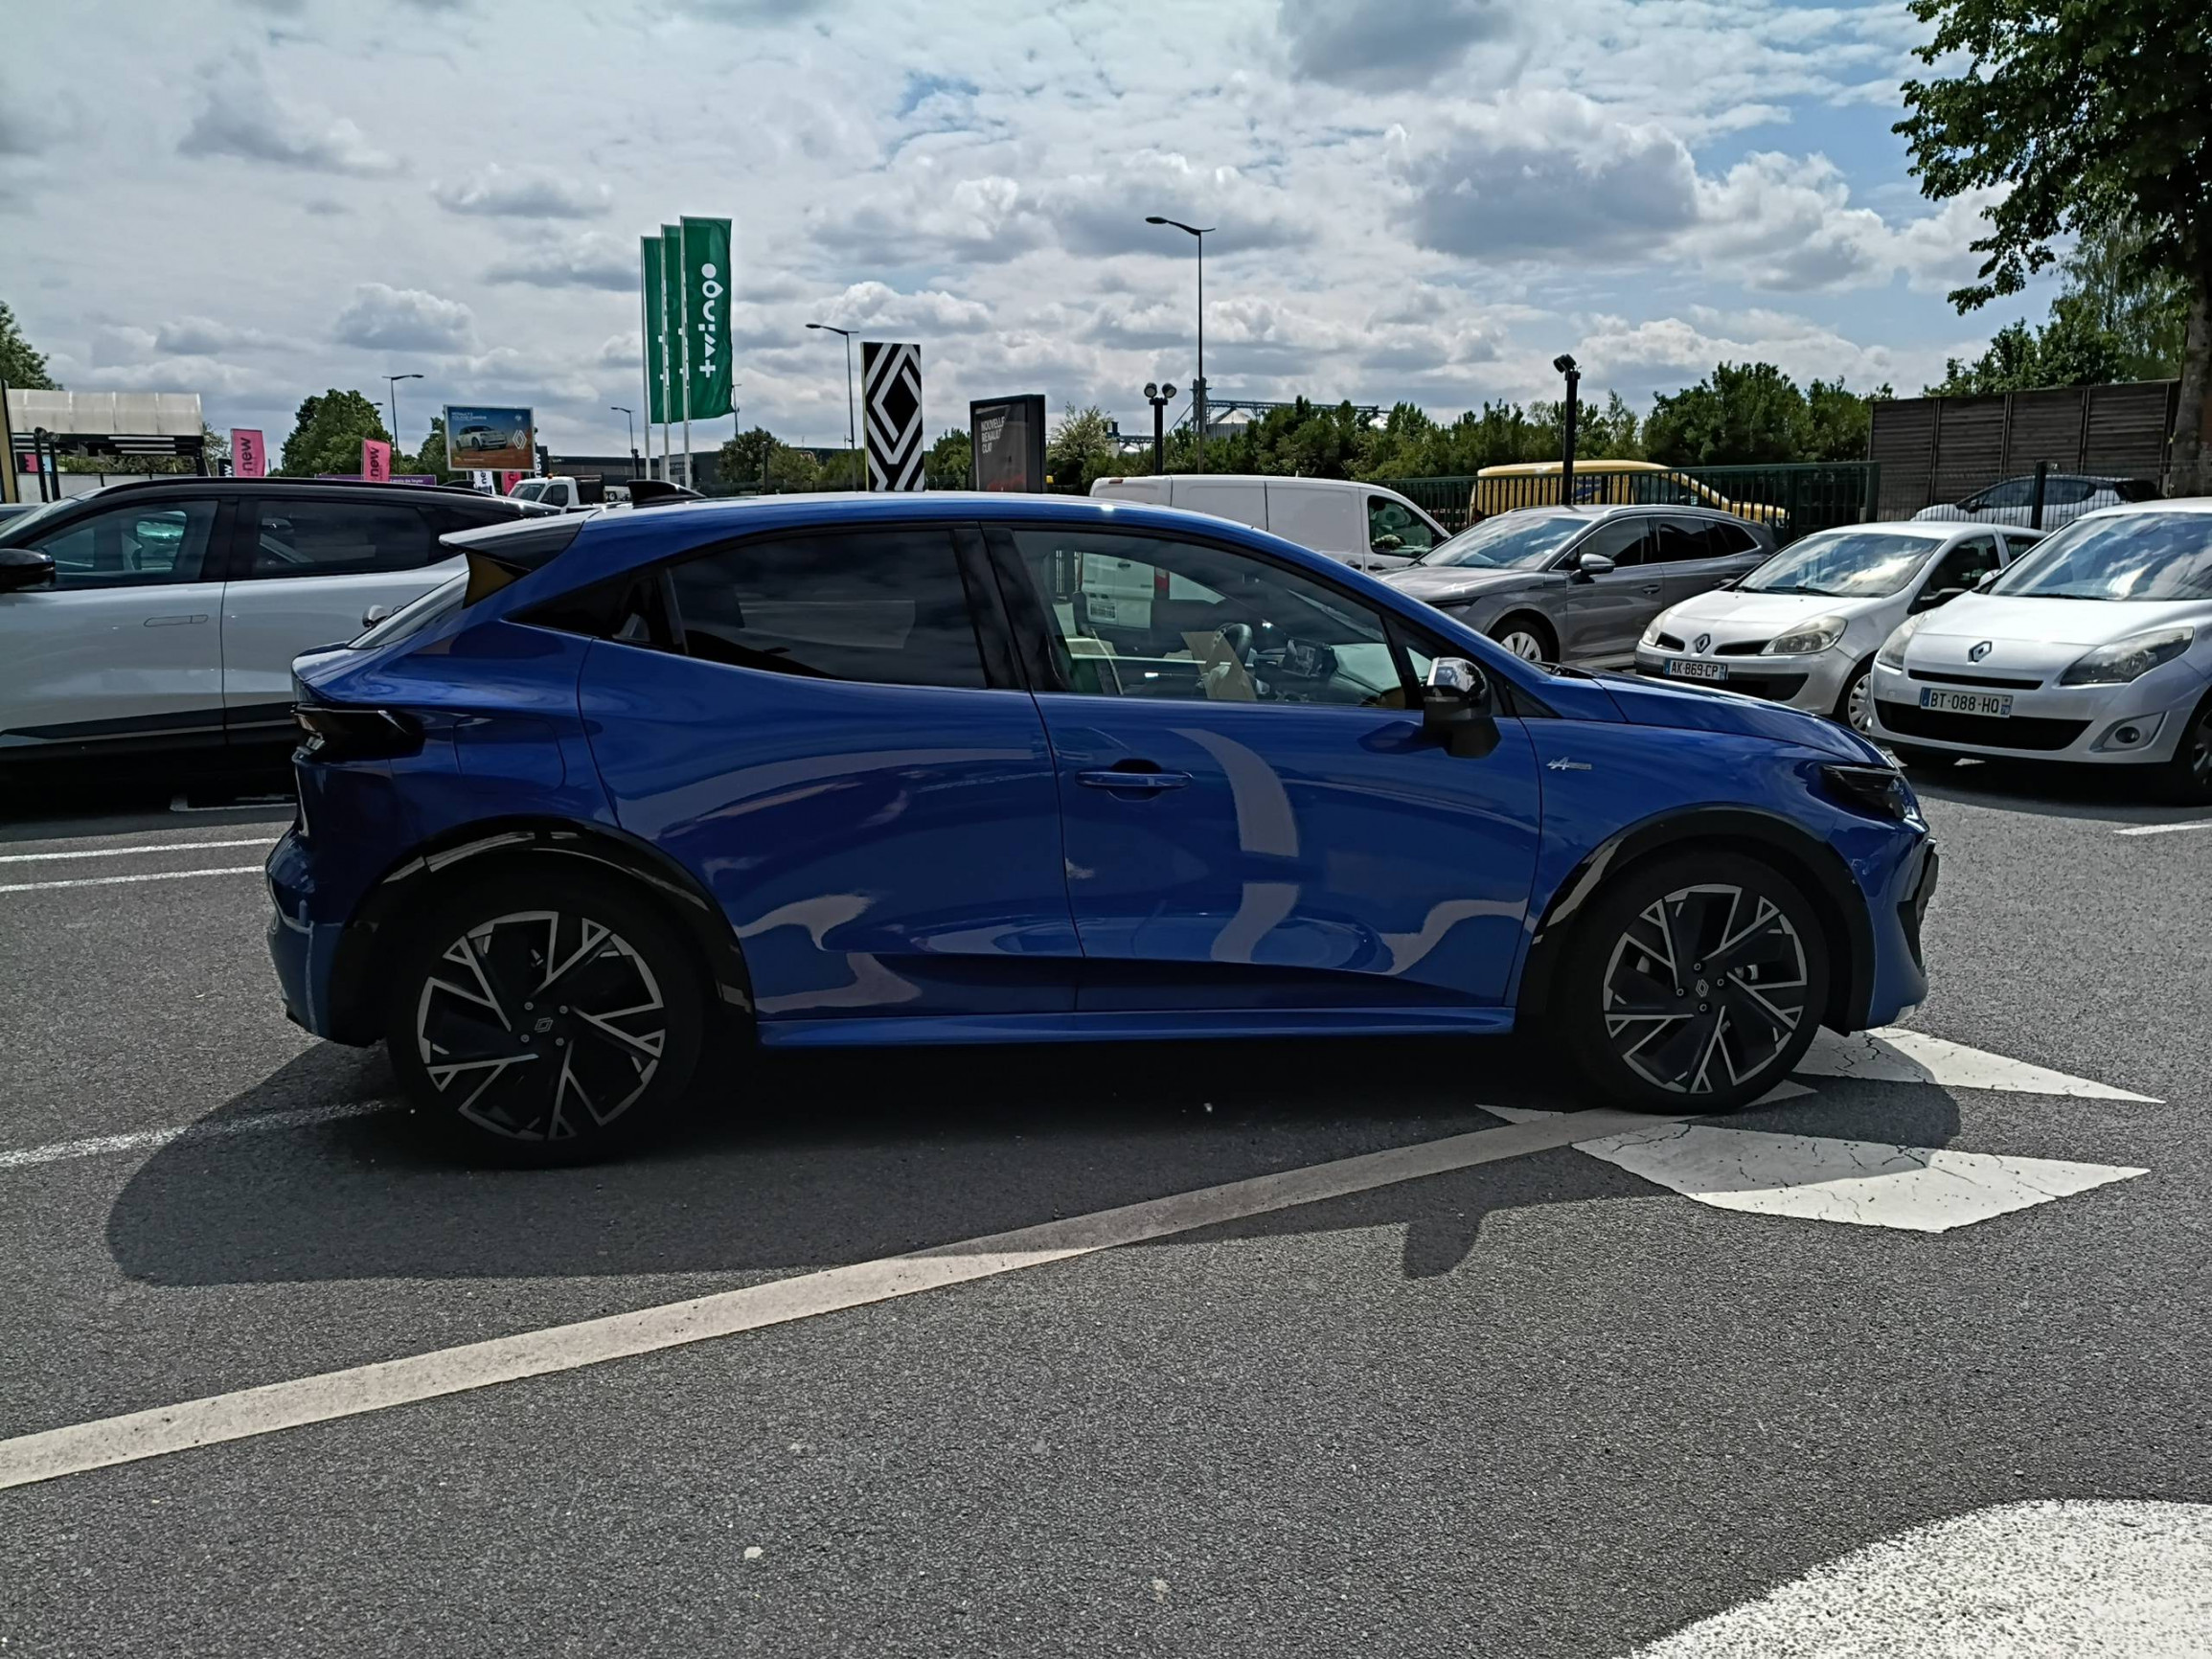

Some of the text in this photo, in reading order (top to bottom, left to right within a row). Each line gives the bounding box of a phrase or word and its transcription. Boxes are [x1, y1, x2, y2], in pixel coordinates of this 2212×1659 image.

[240, 437, 253, 472] new
[370, 447, 379, 477] new
[1671, 661, 1719, 678] AK-869-CP
